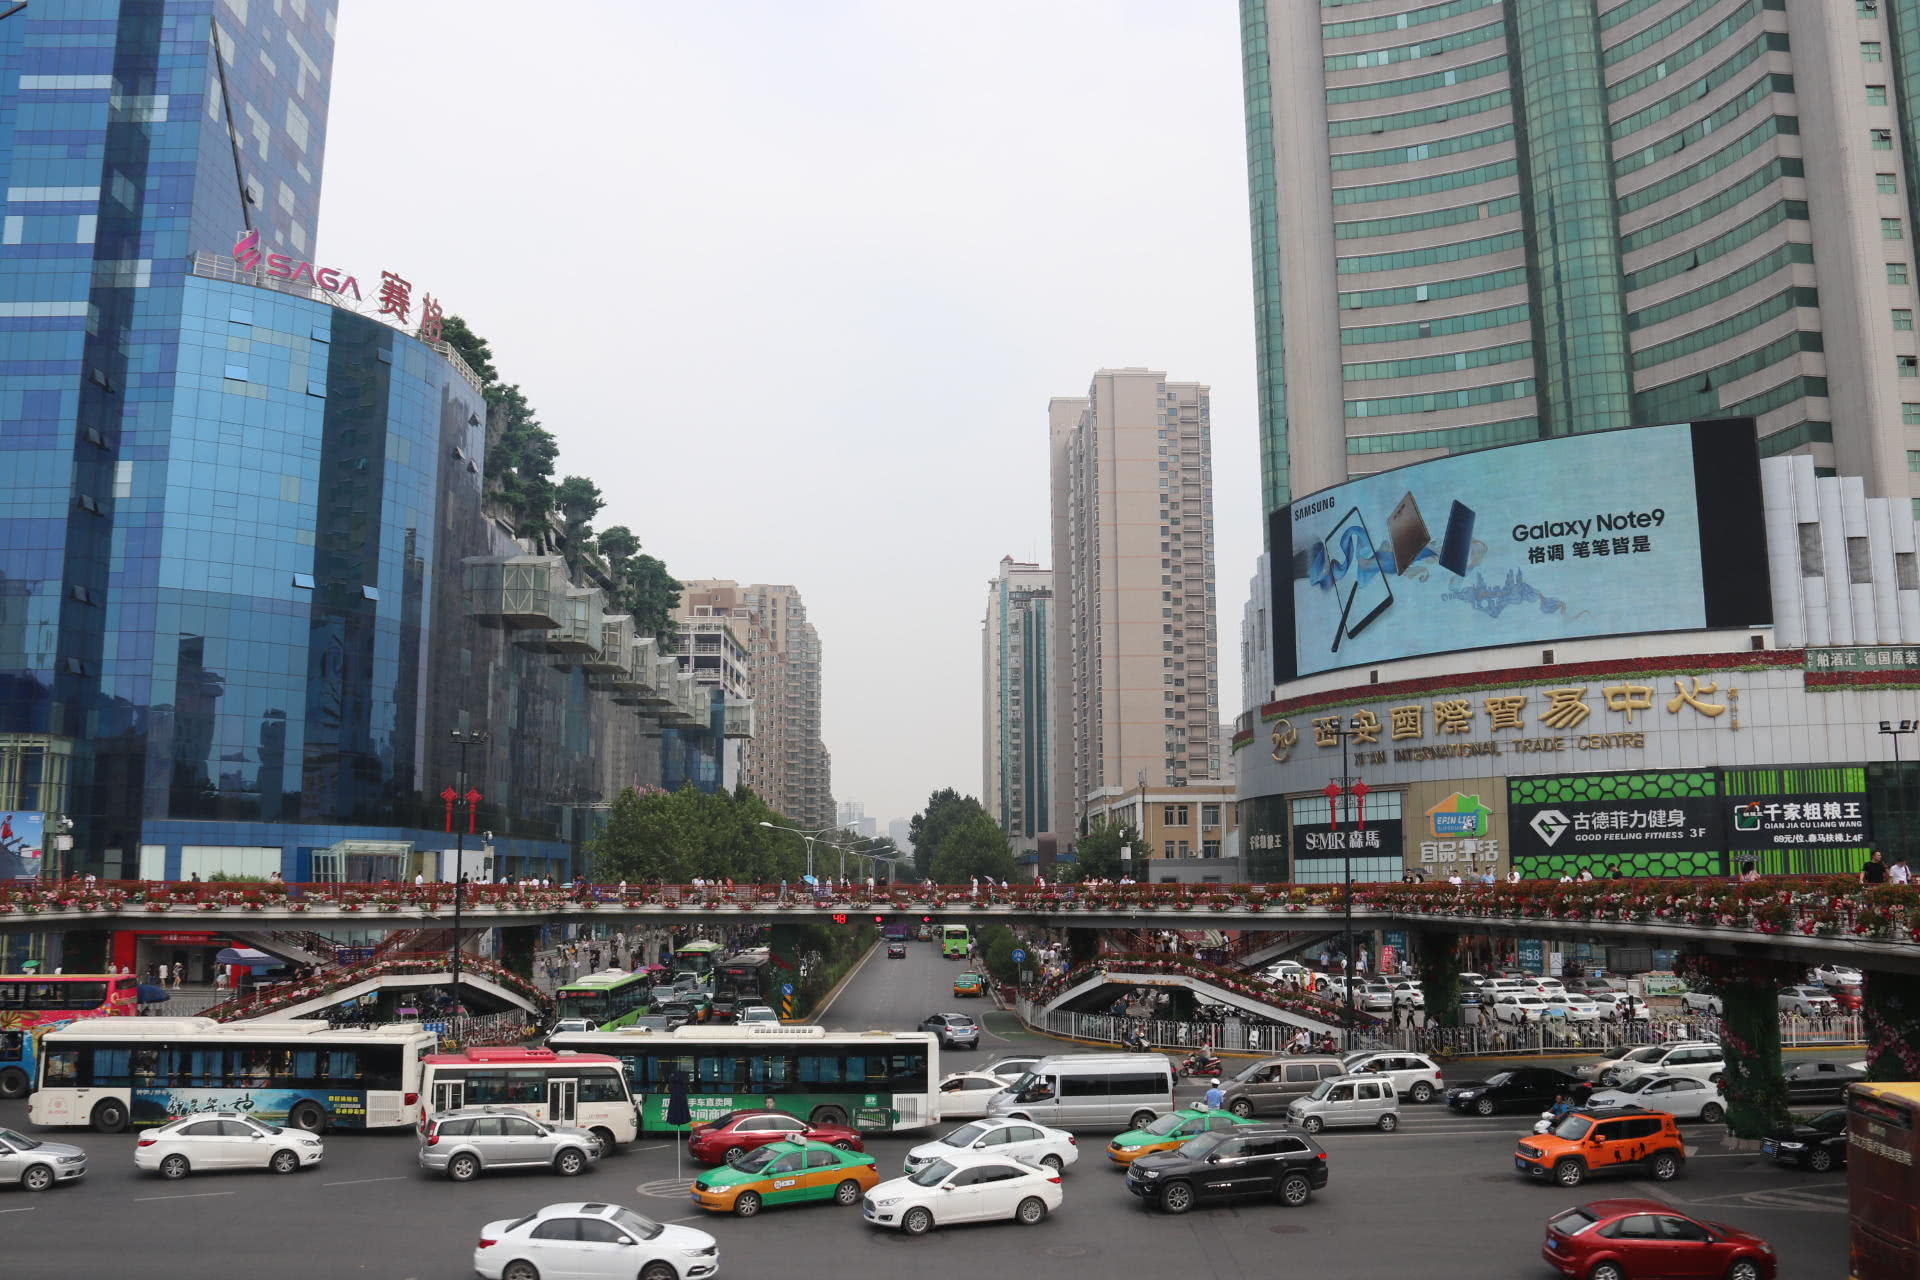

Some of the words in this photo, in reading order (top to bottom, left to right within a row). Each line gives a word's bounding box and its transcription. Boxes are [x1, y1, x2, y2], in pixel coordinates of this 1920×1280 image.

[266, 252, 362, 301] SAGA
[1294, 496, 1335, 521] SAMSUNG
[1512, 514, 1592, 543] Galaxy
[1597, 508, 1665, 534] Note9
[1528, 544, 1564, 565] 格调
[1573, 534, 1651, 560] 笔笔皆是
[1394, 740, 1499, 763] INTERNATIONAL
[1511, 736, 1567, 754] TRADE
[1576, 733, 1645, 750] CENTRE
[1572, 809, 1686, 831] 古德菲力健身
[1763, 801, 1862, 822] 千家粗粮王
[1575, 833, 1602, 842] GOOD
[1604, 832, 1642, 841] FEELING
[1645, 830, 1684, 840] FITNESS
[1689, 828, 1707, 838] 3F
[1800, 821, 1811, 829] CU
[1838, 820, 1863, 828] WANG
